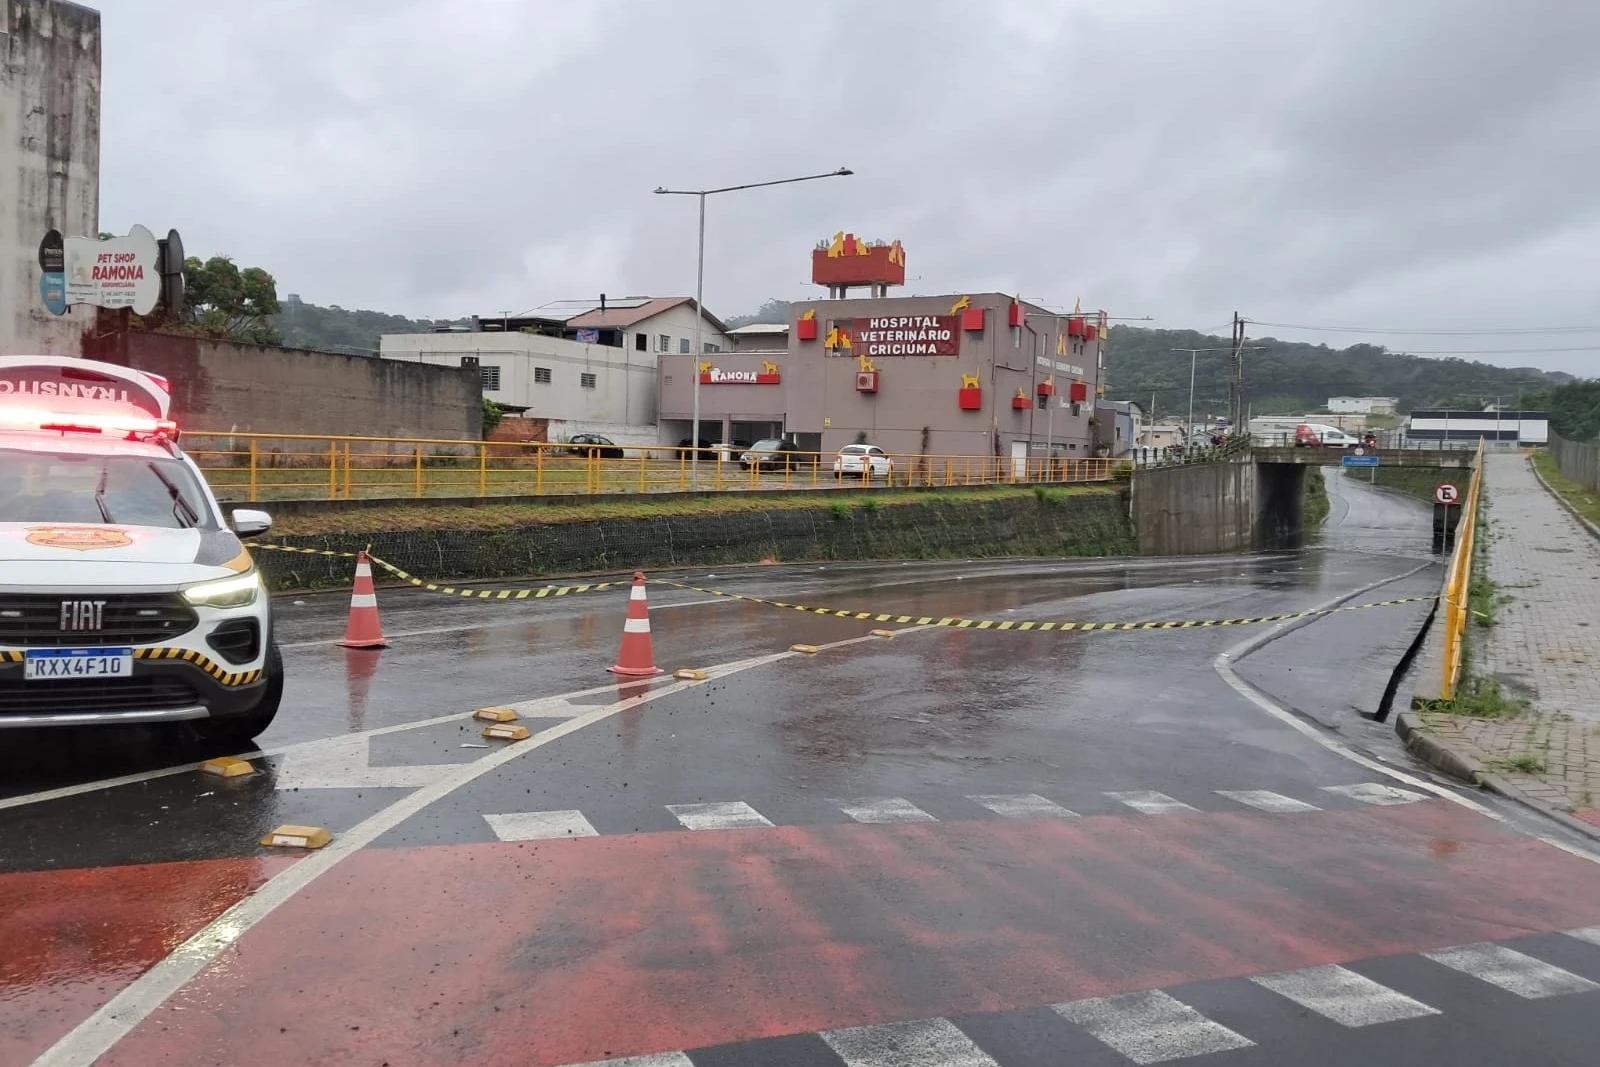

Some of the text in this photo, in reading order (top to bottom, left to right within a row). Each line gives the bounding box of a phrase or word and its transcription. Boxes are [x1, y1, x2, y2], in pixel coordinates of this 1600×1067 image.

[98, 253, 135, 262] PET SHOP
[92, 265, 144, 280] RAMONA
[870, 316, 940, 329] HOSPITAL
[860, 327, 951, 342] VETERINÁRIO
[869, 340, 937, 355] CRICIÚMA
[710, 367, 757, 383] RAMONA
[60, 601, 106, 630] FIAT
[35, 658, 120, 676] RXX4F10
